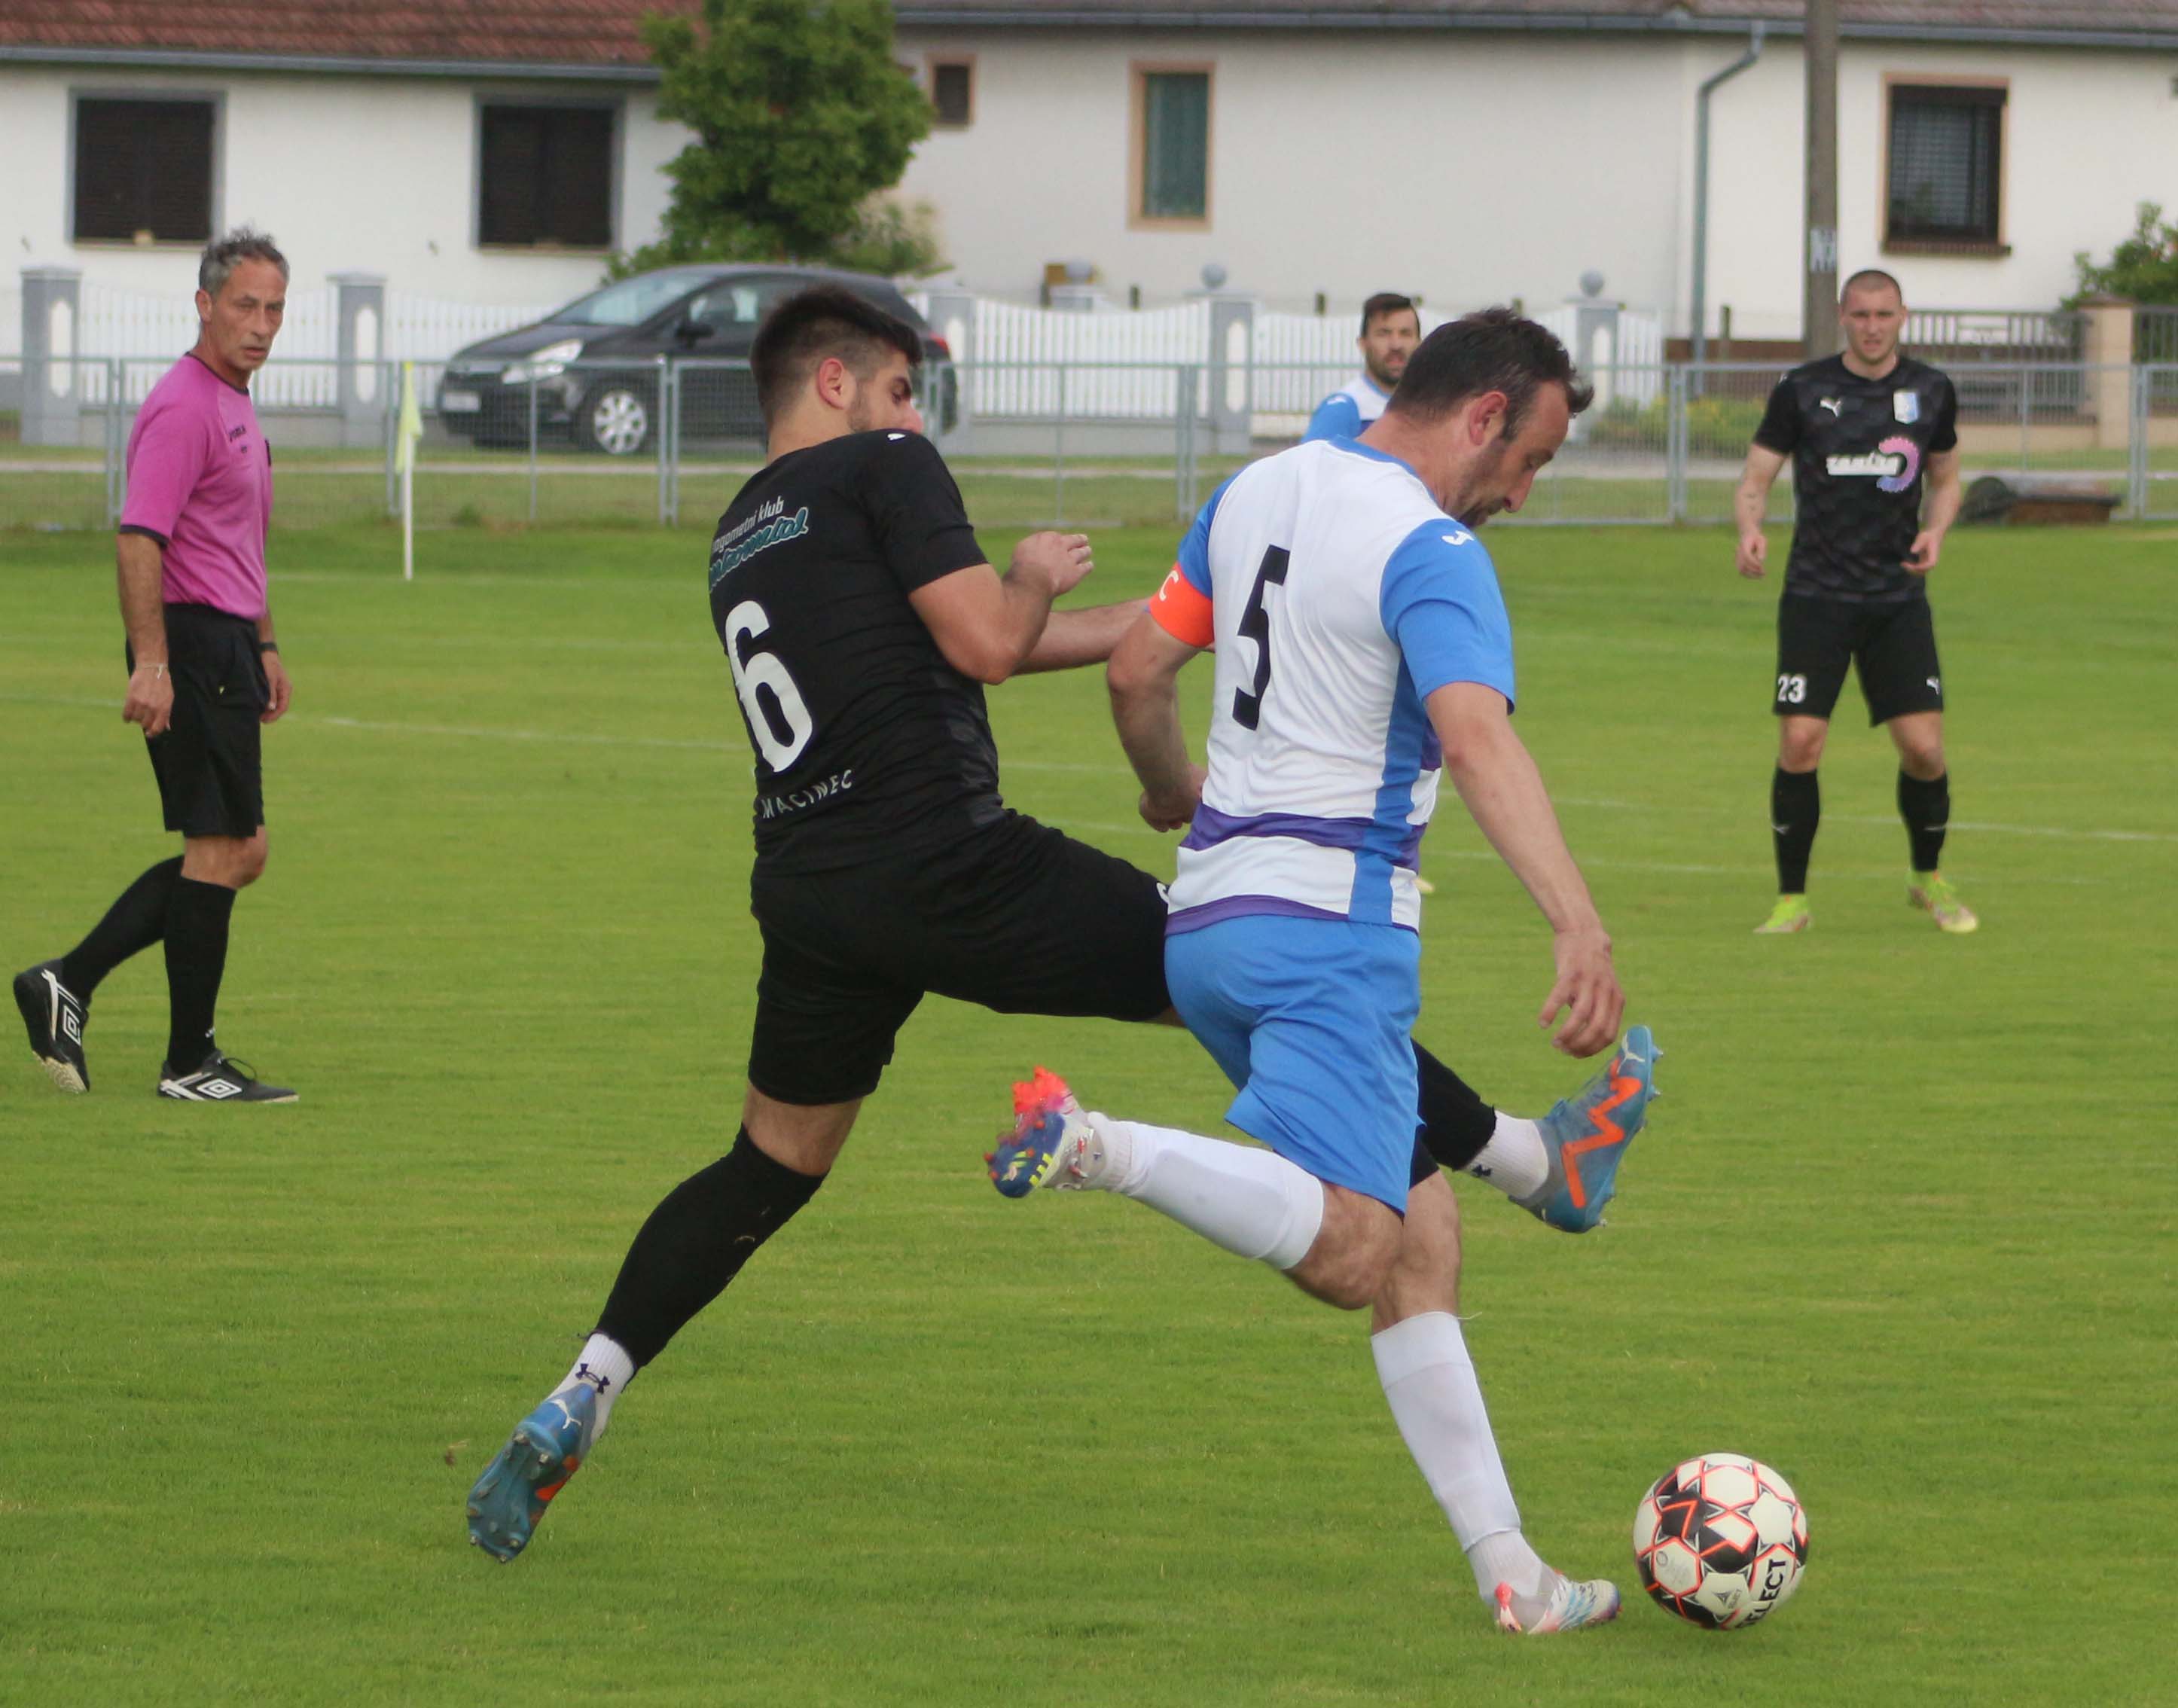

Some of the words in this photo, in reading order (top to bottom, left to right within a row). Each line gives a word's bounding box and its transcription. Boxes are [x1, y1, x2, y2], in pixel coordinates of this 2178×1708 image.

[758, 495, 784, 523] klub
[1158, 569, 1179, 602] C
[1232, 544, 1290, 731] 5
[725, 600, 813, 773] 6
[1777, 675, 1807, 703] 23
